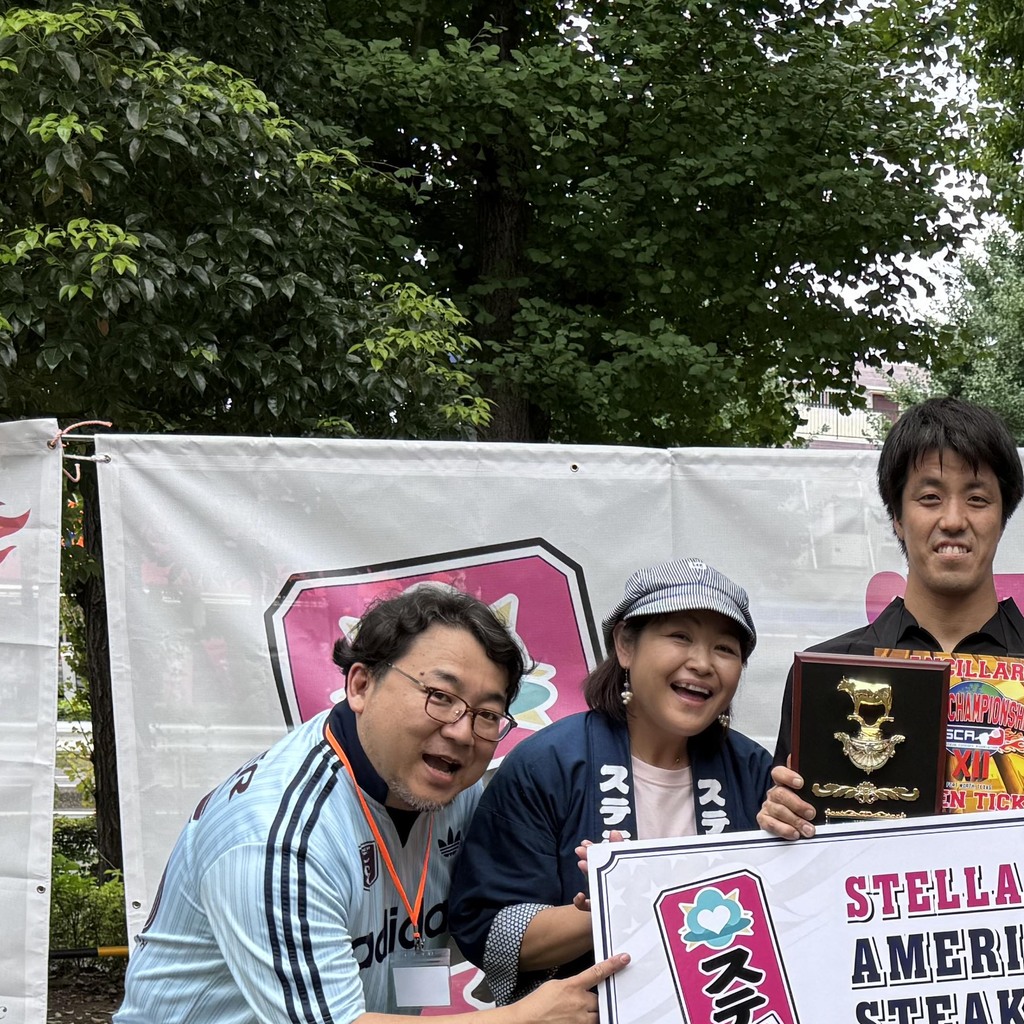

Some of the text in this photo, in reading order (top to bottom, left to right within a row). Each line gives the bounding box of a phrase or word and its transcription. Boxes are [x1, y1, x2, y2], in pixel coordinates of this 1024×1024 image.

[952, 749, 991, 780] XII
[599, 764, 631, 843] ステ
[352, 897, 450, 971] adida
